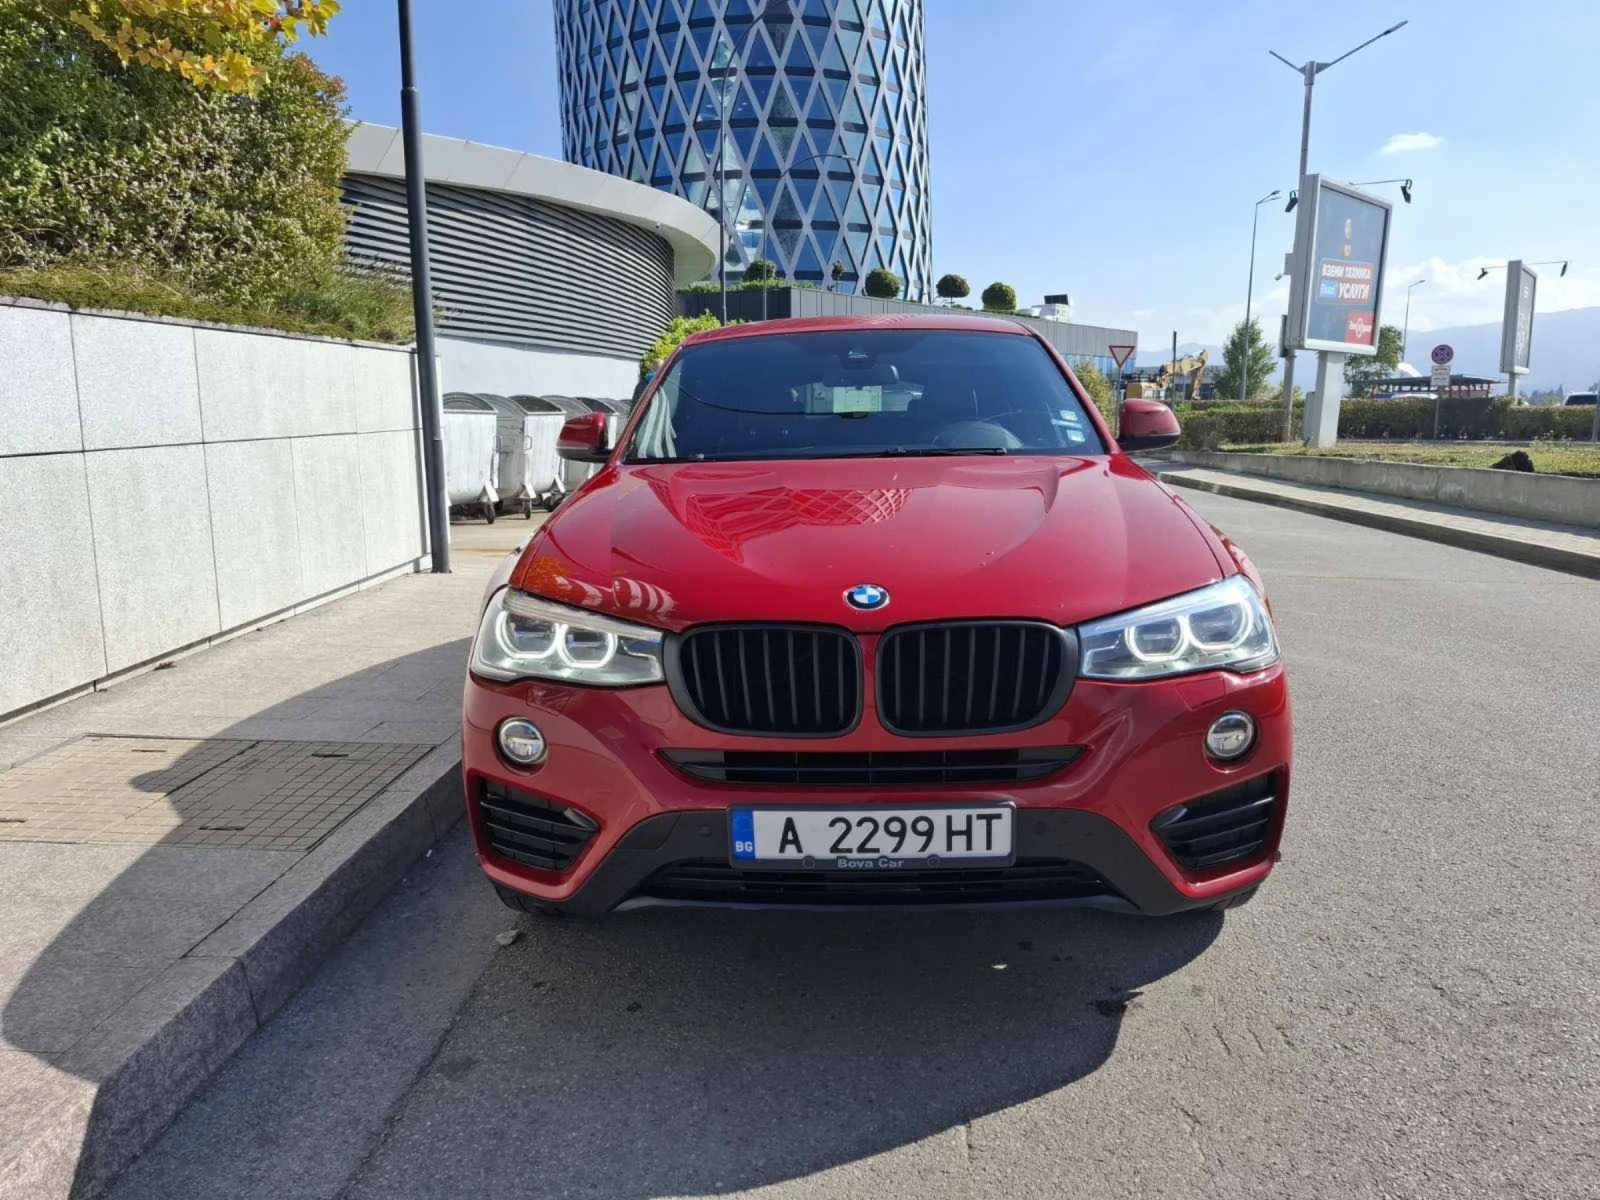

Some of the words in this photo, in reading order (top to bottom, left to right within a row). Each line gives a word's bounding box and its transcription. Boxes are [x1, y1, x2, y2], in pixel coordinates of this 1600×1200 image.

[1338, 282, 1370, 299] УСЛУГИ
[778, 816, 803, 854] A
[735, 840, 753, 852] BG
[837, 857, 873, 869] Bova
[878, 857, 904, 869] Car
